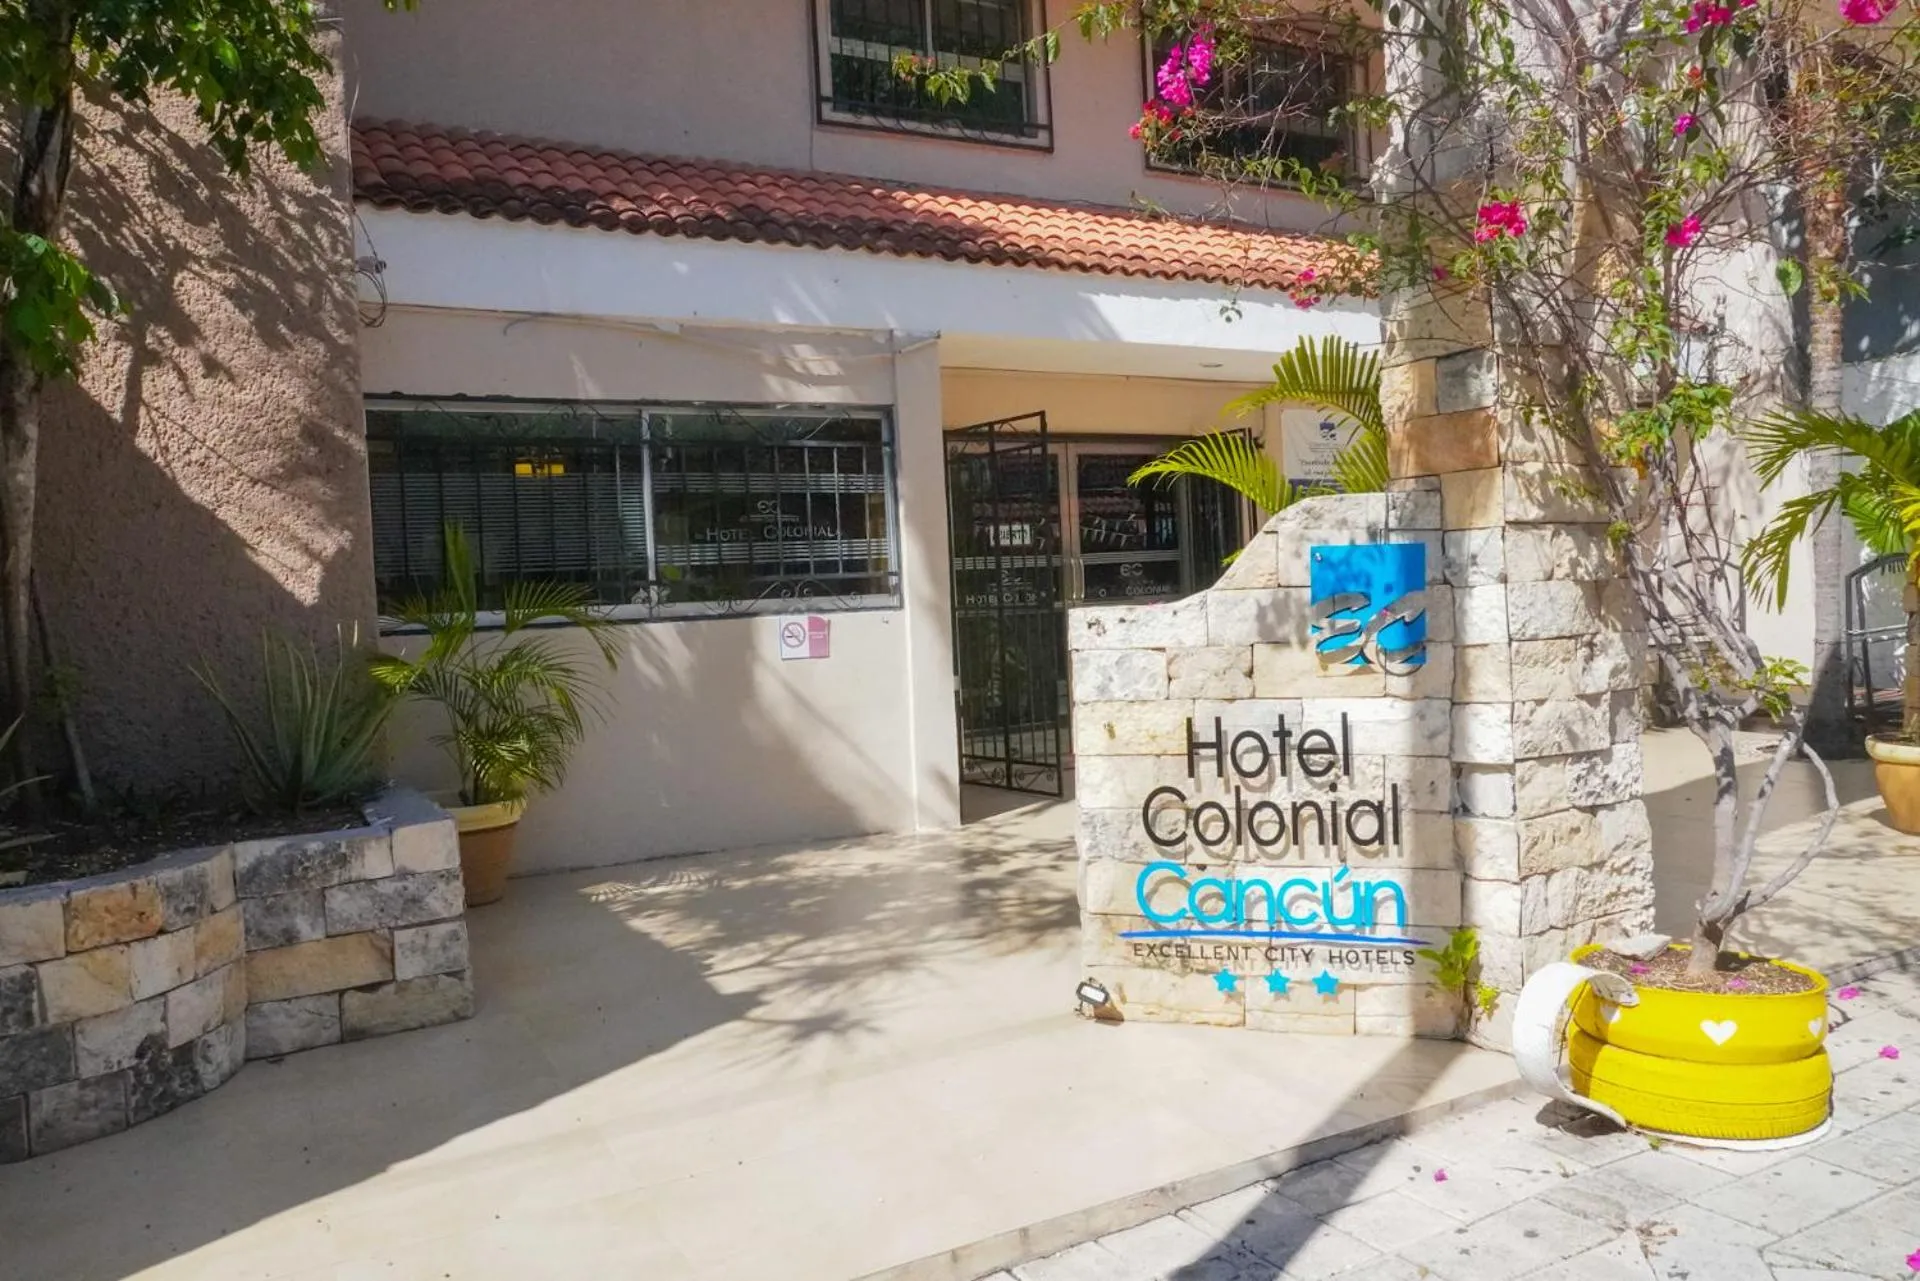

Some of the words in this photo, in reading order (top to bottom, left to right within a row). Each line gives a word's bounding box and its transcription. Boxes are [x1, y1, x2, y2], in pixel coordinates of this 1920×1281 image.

[1186, 712, 1350, 779] Hotel
[1142, 782, 1401, 847] Colonial
[1136, 861, 1406, 928] Cancún
[1133, 943, 1252, 962] EXCELLENT
[1263, 946, 1314, 964] CITY
[1328, 949, 1416, 966] HOTELS
